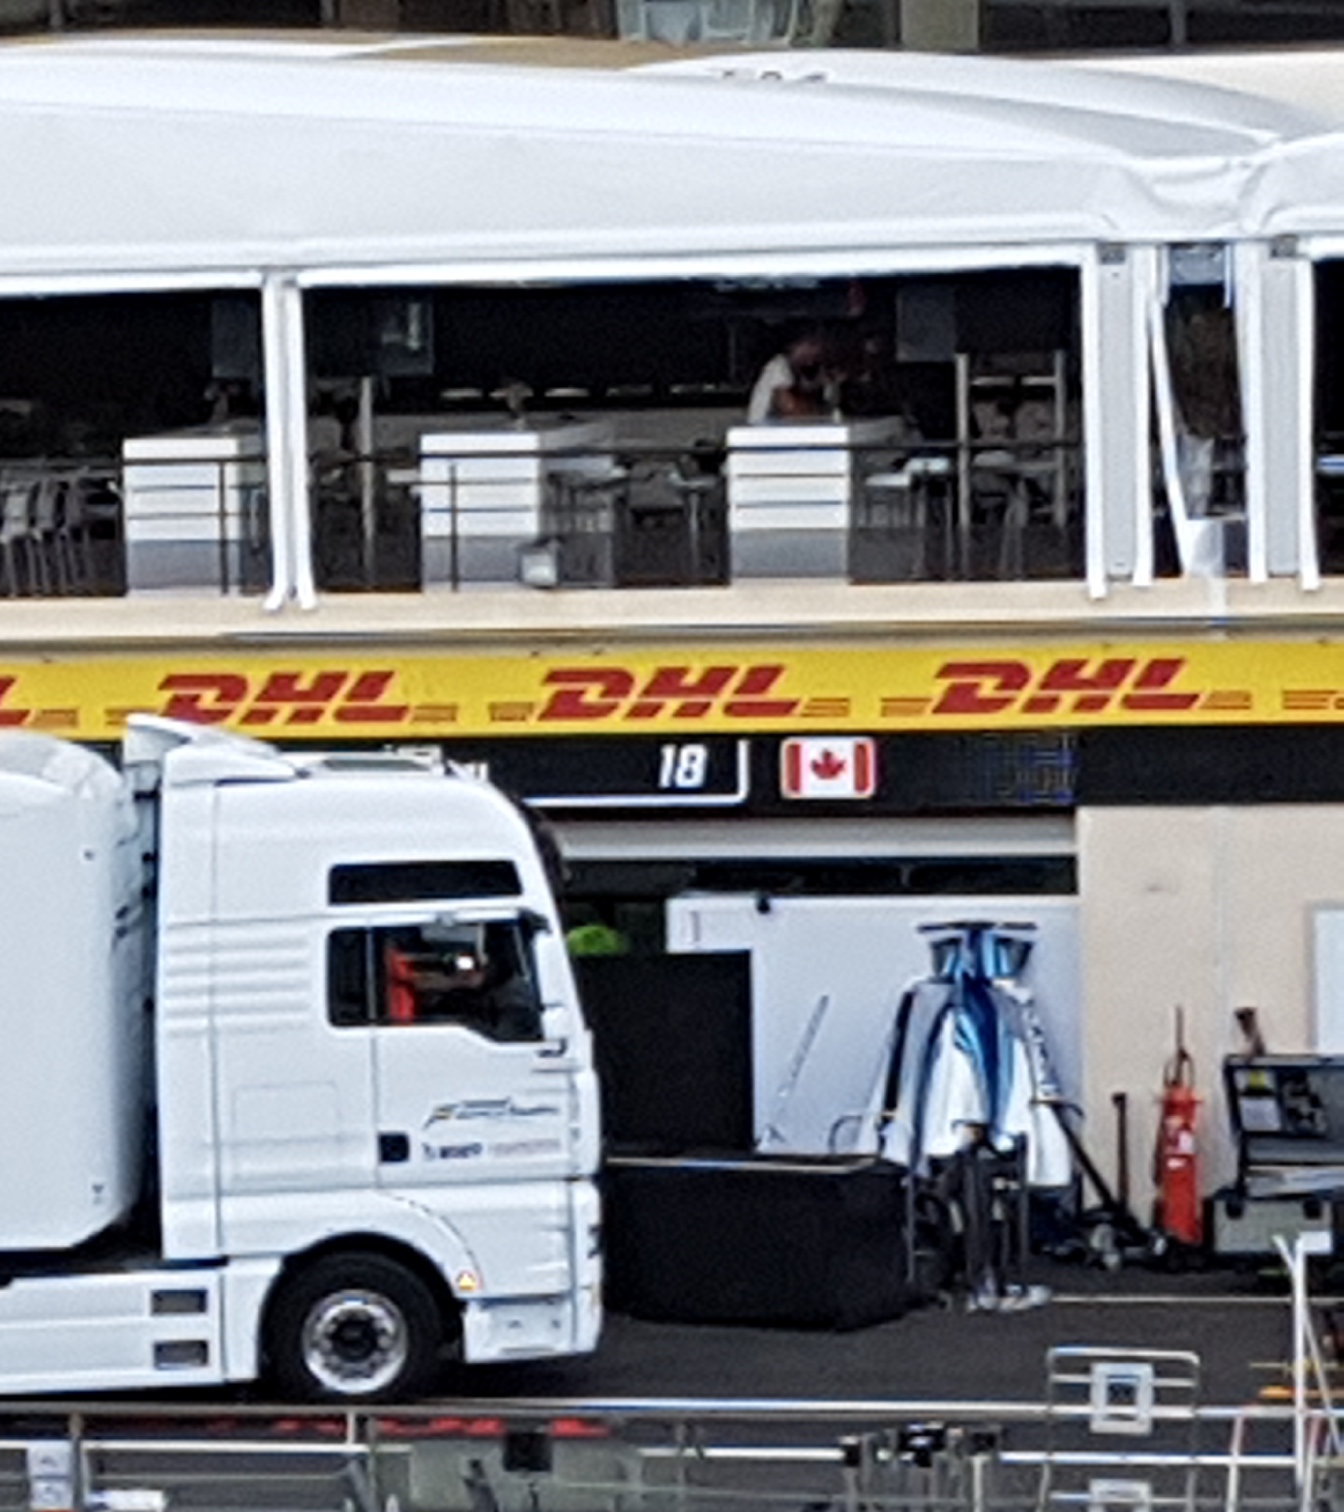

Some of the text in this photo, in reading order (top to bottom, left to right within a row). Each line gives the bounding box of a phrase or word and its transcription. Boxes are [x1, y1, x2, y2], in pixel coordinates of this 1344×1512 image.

[158, 670, 410, 725] DHL
[538, 665, 804, 720] DHL
[929, 659, 1202, 714] DHL
[658, 744, 709, 788] 18
